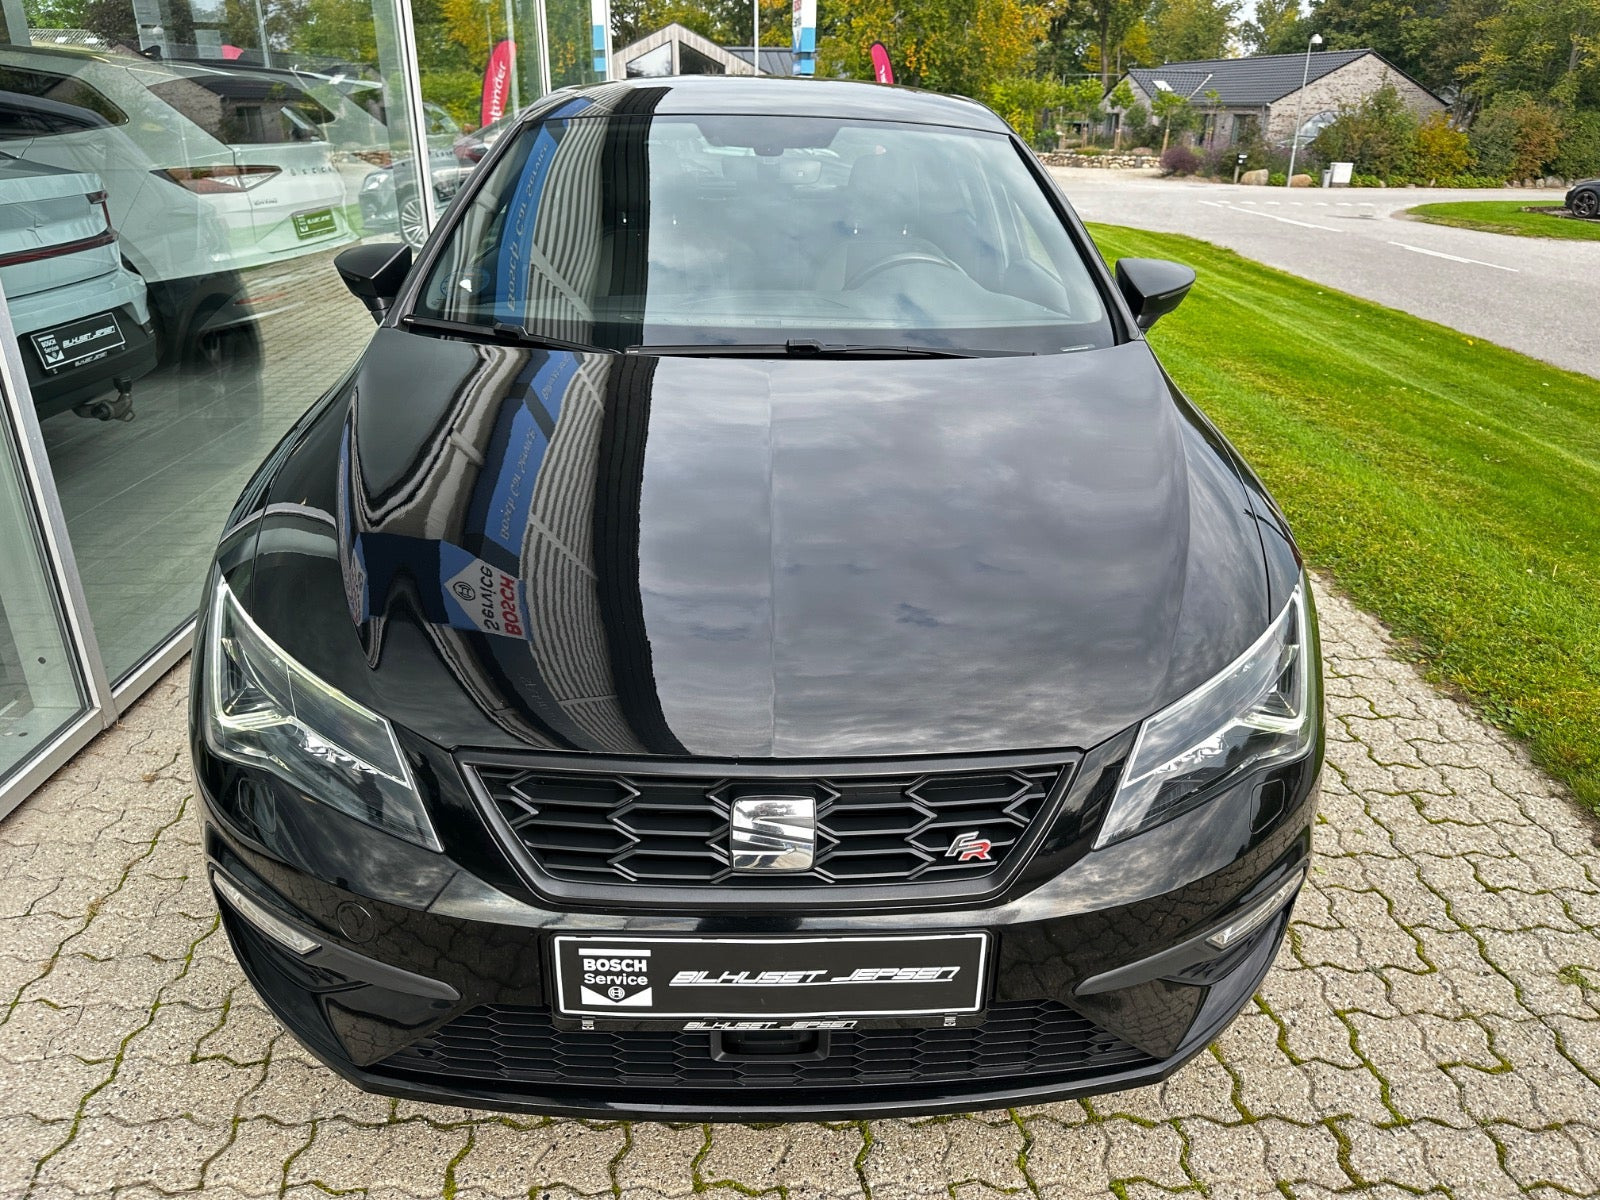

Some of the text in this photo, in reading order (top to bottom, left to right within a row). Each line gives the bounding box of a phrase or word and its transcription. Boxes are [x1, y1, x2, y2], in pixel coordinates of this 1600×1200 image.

[944, 830, 992, 862] FR
[582, 958, 648, 973] BOSCH
[583, 972, 649, 986] Service
[669, 965, 961, 986] BILHUSET JEPSEN
[682, 1020, 859, 1031] BILHUSET JEPSEN
